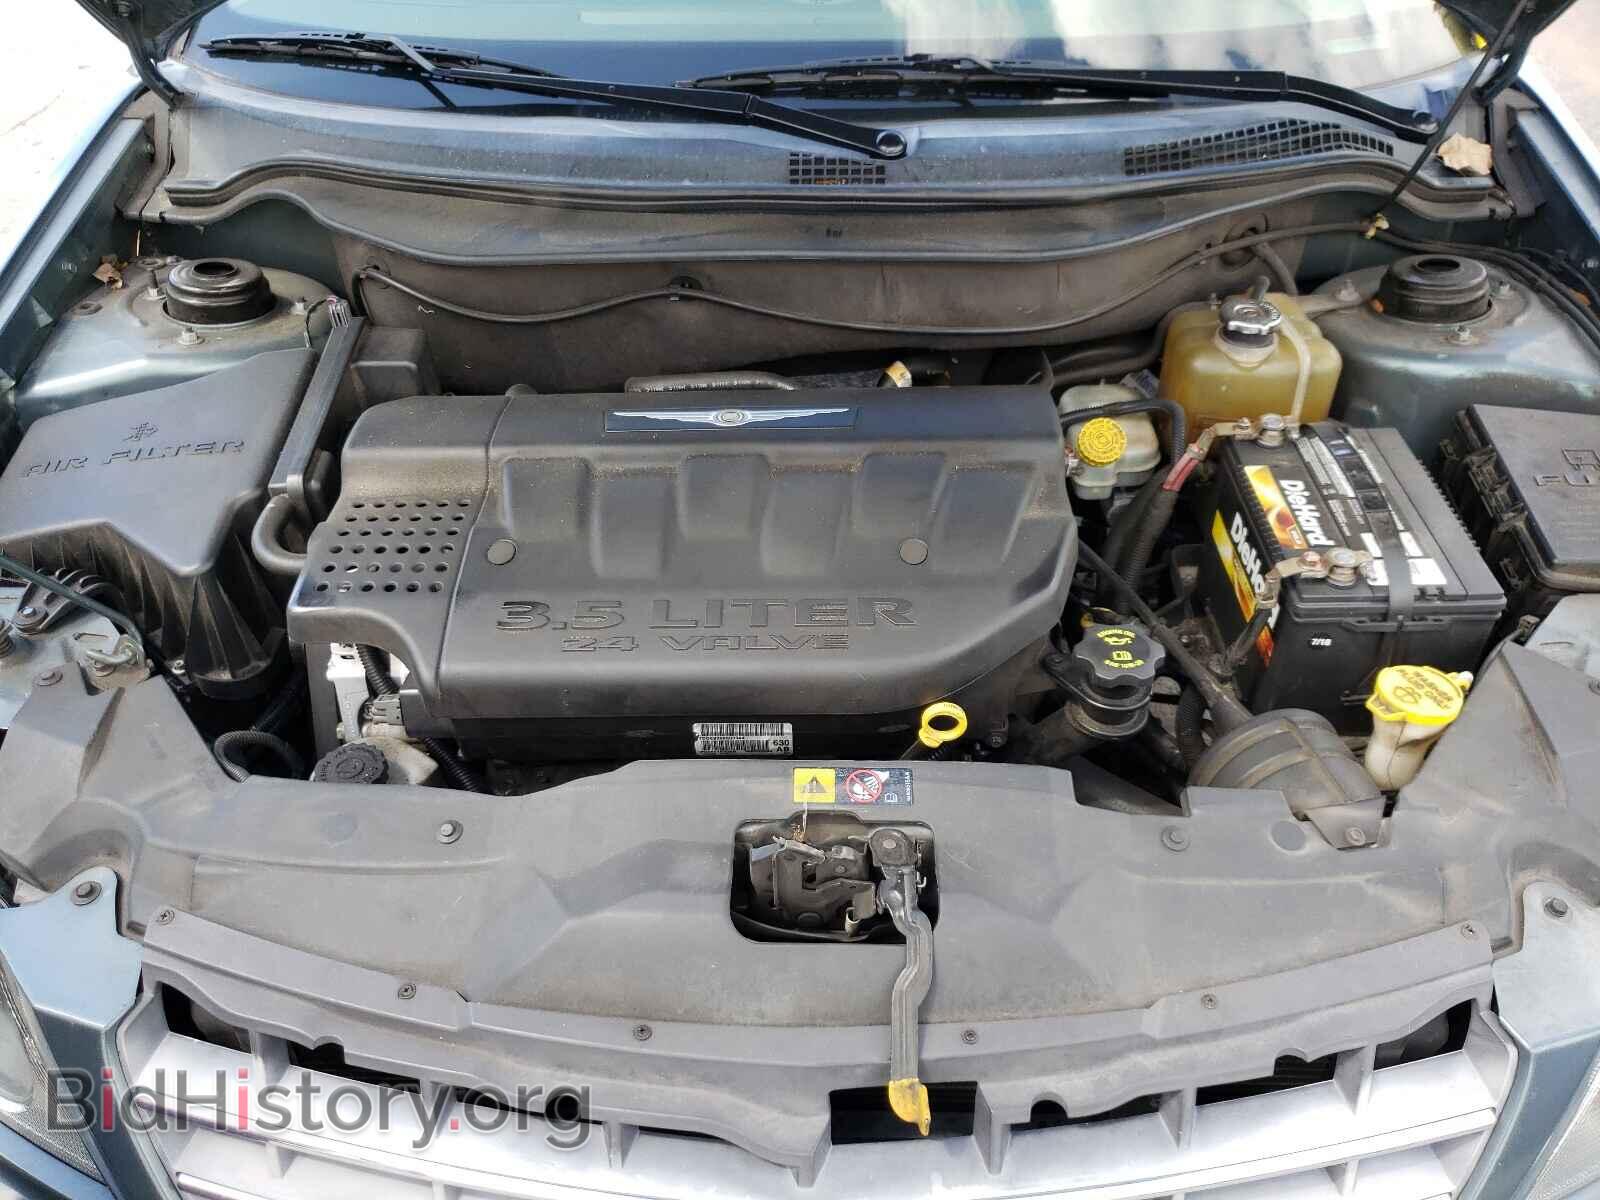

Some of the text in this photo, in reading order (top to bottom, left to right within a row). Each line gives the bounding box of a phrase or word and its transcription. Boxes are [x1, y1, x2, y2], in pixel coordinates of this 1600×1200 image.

[20, 440, 245, 478] AIR FILTER
[1279, 479, 1336, 547] DieHard
[496, 597, 917, 630] 3.5 LITER
[561, 633, 849, 652] 24 VALVE
